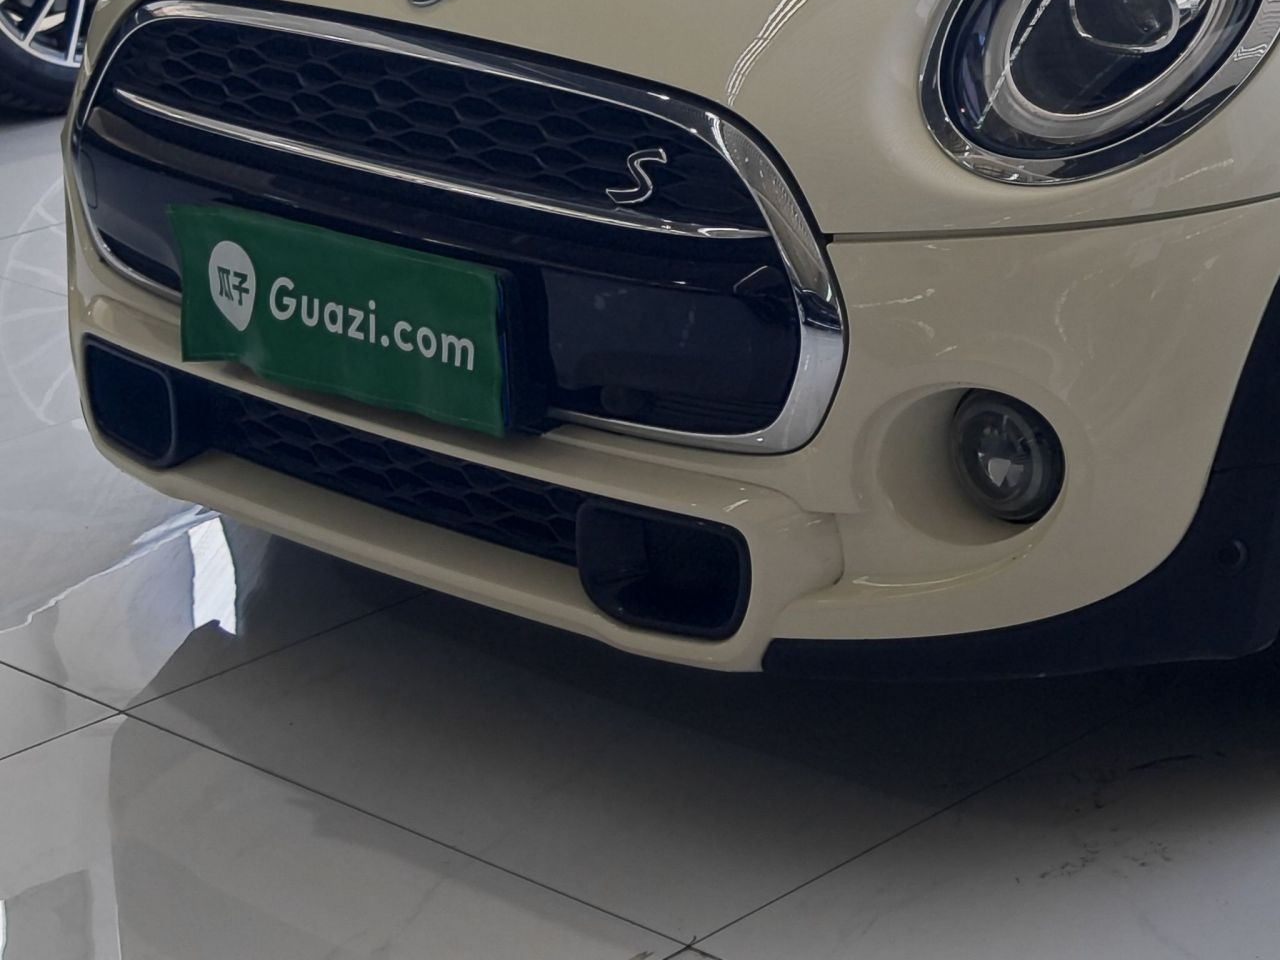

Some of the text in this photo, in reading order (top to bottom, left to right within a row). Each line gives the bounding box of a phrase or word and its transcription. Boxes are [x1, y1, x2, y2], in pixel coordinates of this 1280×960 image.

[605, 147, 667, 204] S
[217, 266, 250, 306] 瓜子
[269, 276, 475, 372] Guazi.com
